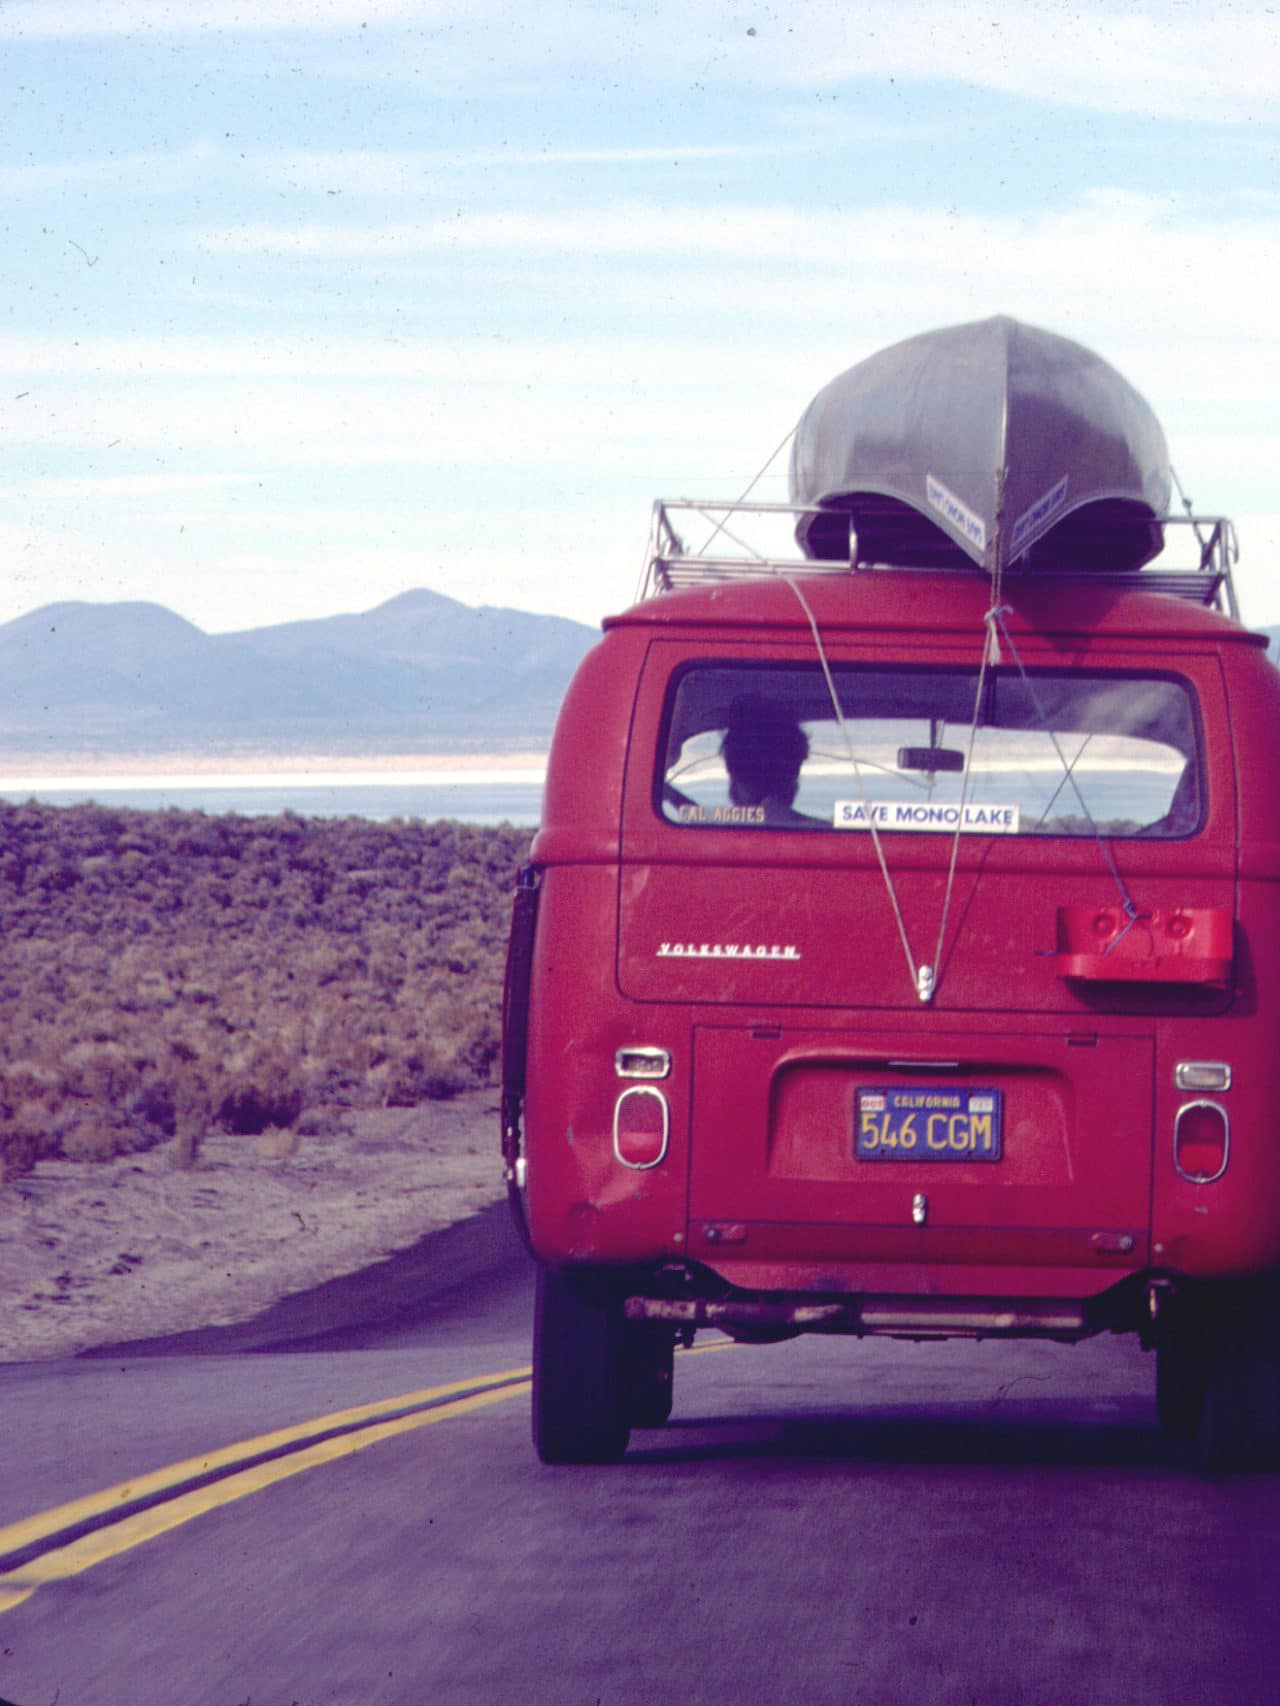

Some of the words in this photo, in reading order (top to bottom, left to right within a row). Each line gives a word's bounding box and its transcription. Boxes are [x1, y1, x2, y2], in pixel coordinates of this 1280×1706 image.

[713, 807, 765, 823] AGGIES
[896, 808, 959, 823] MONO
[965, 809, 1012, 825] LAKE
[657, 942, 800, 959] VOLKSWAGEN
[894, 1095, 961, 1109] CALIFORNIA
[861, 1113, 917, 1149] 546
[927, 1113, 992, 1150] CGM
